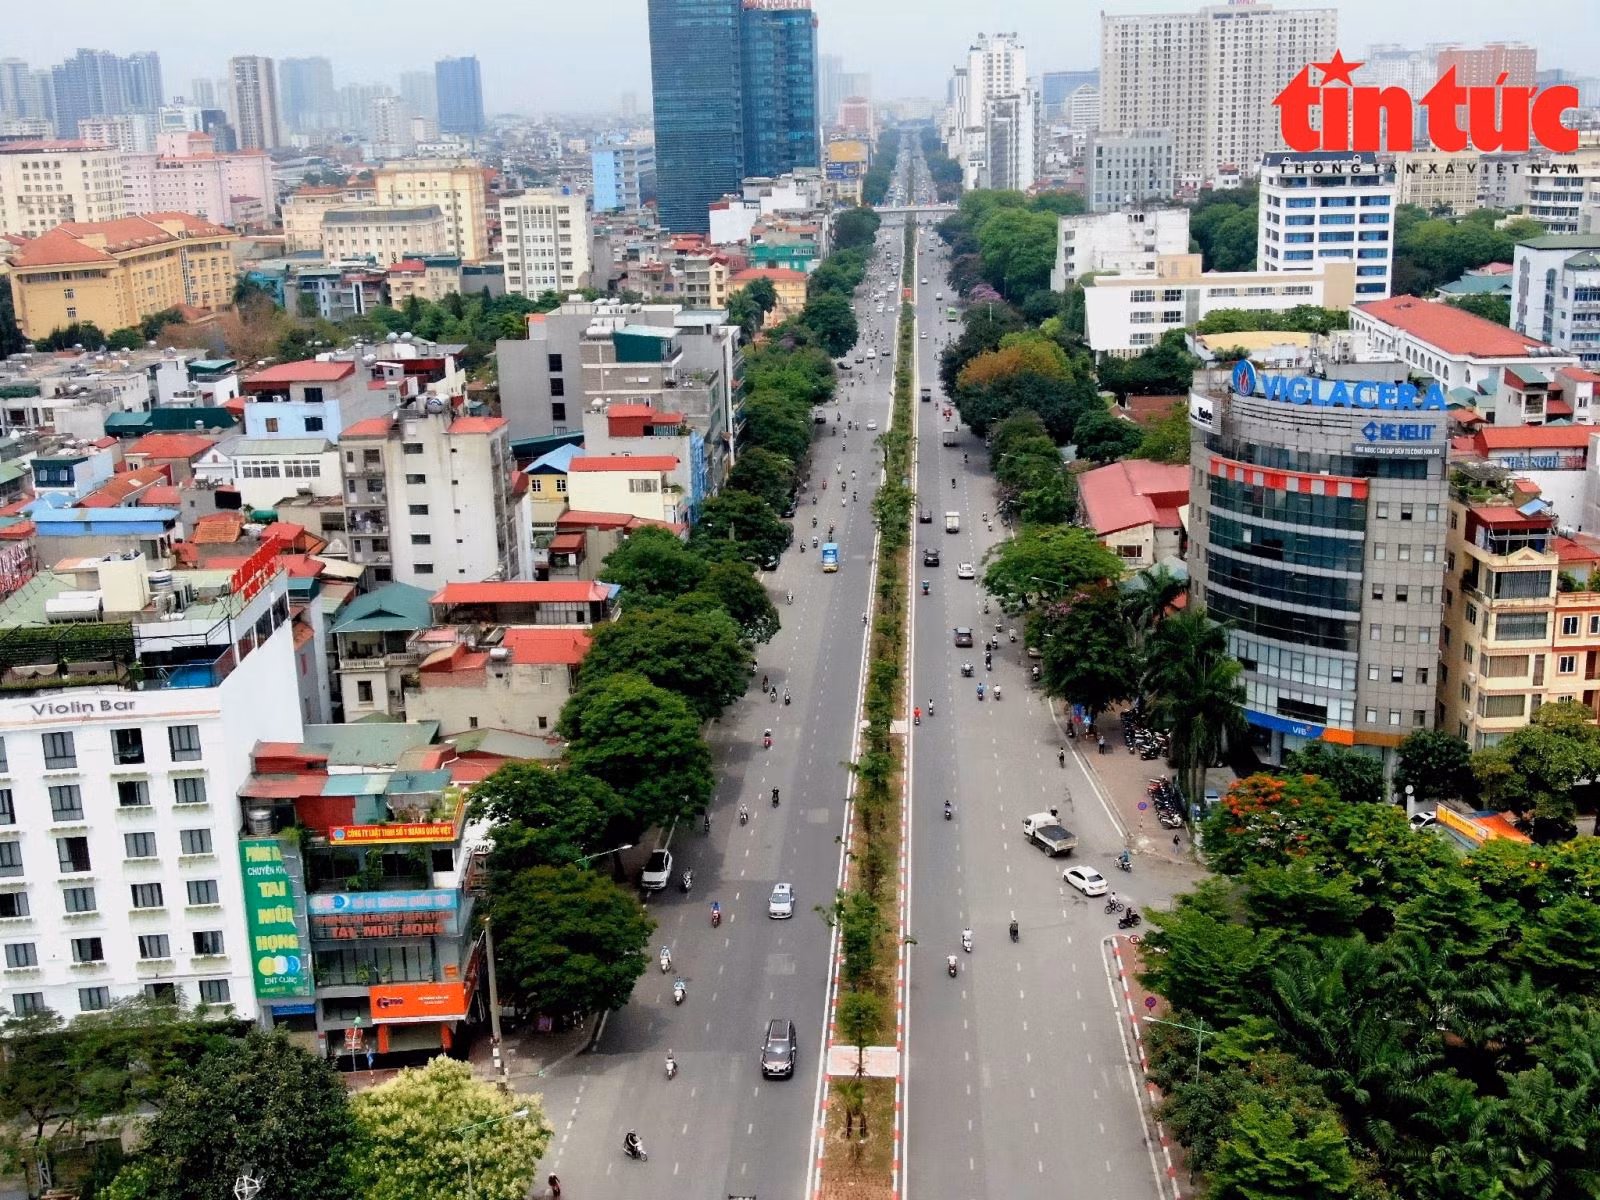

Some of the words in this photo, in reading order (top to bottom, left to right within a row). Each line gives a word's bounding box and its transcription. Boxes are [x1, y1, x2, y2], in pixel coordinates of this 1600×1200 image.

[1261, 374, 1448, 411] VIGLACERA
[31, 700, 95, 716] Violin
[99, 700, 136, 712] Bar
[1292, 725, 1307, 736] VIB
